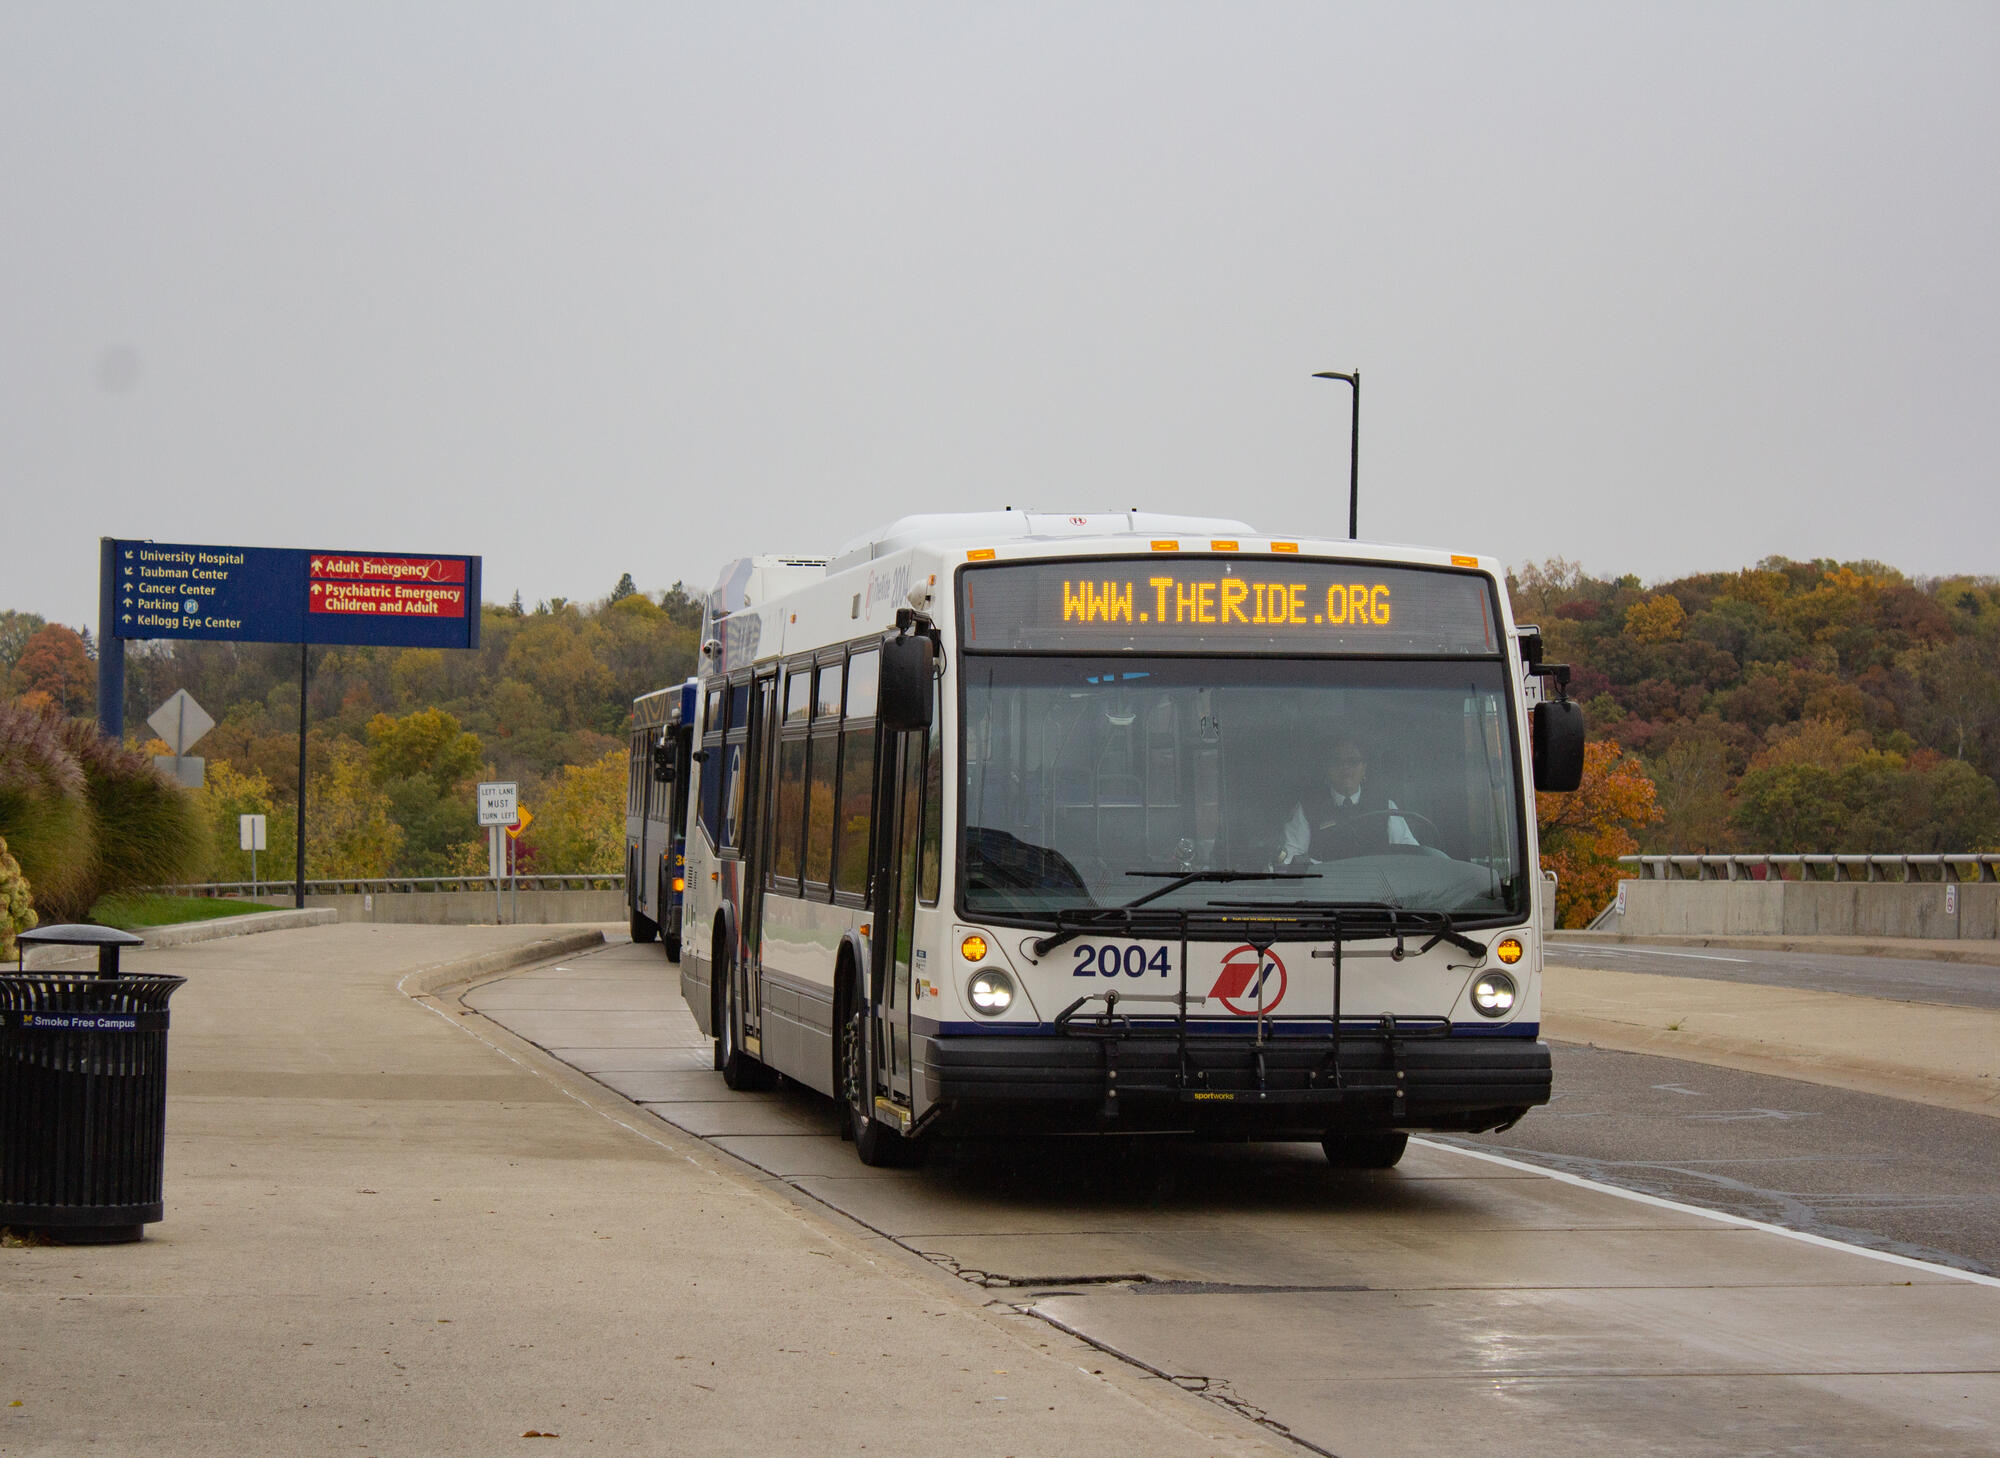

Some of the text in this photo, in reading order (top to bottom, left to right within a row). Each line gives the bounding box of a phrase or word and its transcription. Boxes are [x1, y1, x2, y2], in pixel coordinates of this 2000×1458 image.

[140, 550, 244, 566] University Hospital
[140, 566, 228, 579] Taubman Center
[326, 560, 429, 578] Adult Emergency
[138, 583, 216, 595] Cancer Center
[325, 584, 460, 603] Psychiatric Emergency
[138, 599, 196, 613] Parking P1
[325, 599, 438, 613] Children and Adult
[137, 615, 241, 629] Kellogg Eye Center
[488, 800, 508, 808] MUST
[1073, 944, 1172, 978] 2004
[34, 1016, 136, 1030] Smoke Free Campus
[1194, 1092, 1234, 1100] sportworks
